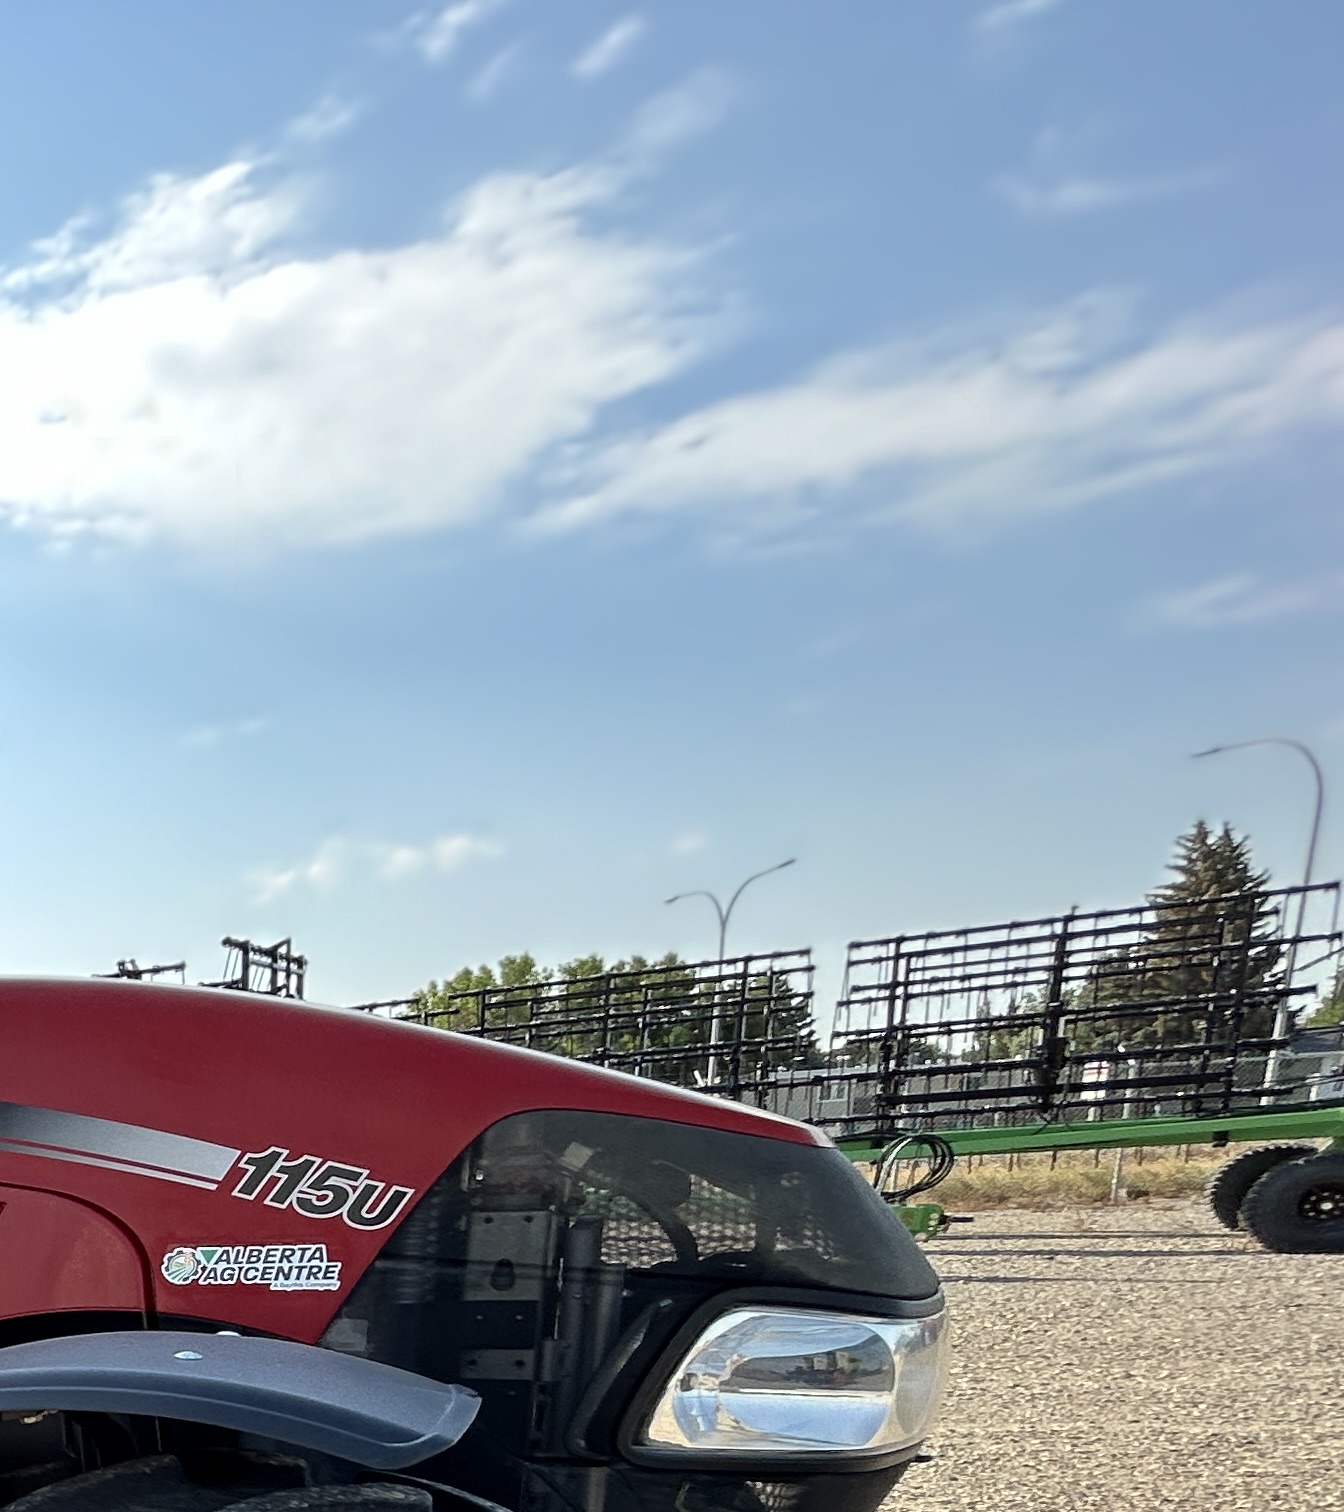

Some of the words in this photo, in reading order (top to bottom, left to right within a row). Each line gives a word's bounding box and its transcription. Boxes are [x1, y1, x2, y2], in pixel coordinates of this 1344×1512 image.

[232, 1145, 416, 1231] 115U
[215, 1246, 325, 1265] ALBERTA
[203, 1265, 239, 1282] AG
[242, 1264, 339, 1282] CENTRE
